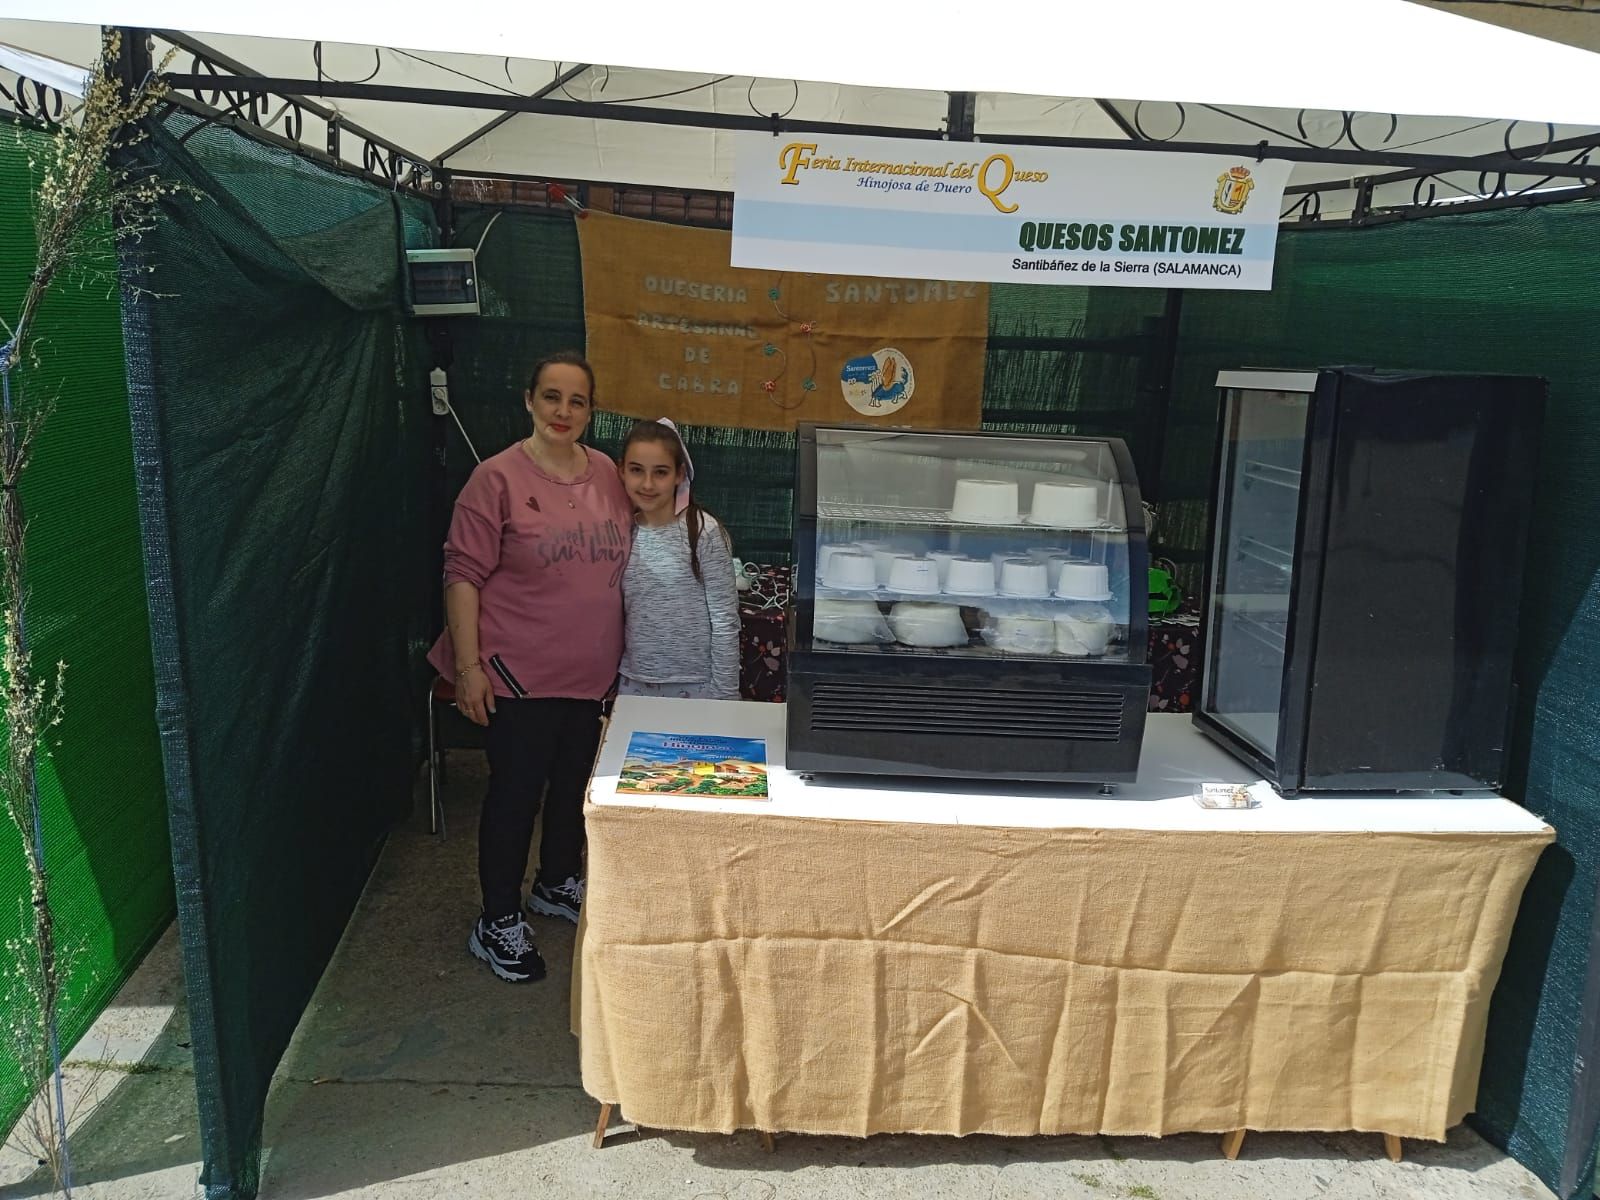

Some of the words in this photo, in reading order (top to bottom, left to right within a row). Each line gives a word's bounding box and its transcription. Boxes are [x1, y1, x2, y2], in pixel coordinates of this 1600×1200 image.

[779, 142, 841, 185] Feria
[842, 157, 953, 179] Internacional
[950, 162, 979, 179] del
[977, 153, 1048, 213] Queso
[856, 176, 912, 193] Hinojosa
[915, 180, 929, 192] de
[934, 182, 972, 193] Duero
[1019, 221, 1115, 252] QUESOS
[1118, 224, 1246, 255] SANTOMEZ
[1012, 258, 1078, 272] Santibáñez
[1081, 261, 1097, 272] de
[1100, 261, 1110, 272] la
[1114, 261, 1149, 273] Sierra
[1153, 262, 1242, 278] (SALAMANCA)
[825, 280, 976, 304] SANTOMEZ
[685, 347, 712, 363] DE
[658, 373, 739, 396] CABRA
